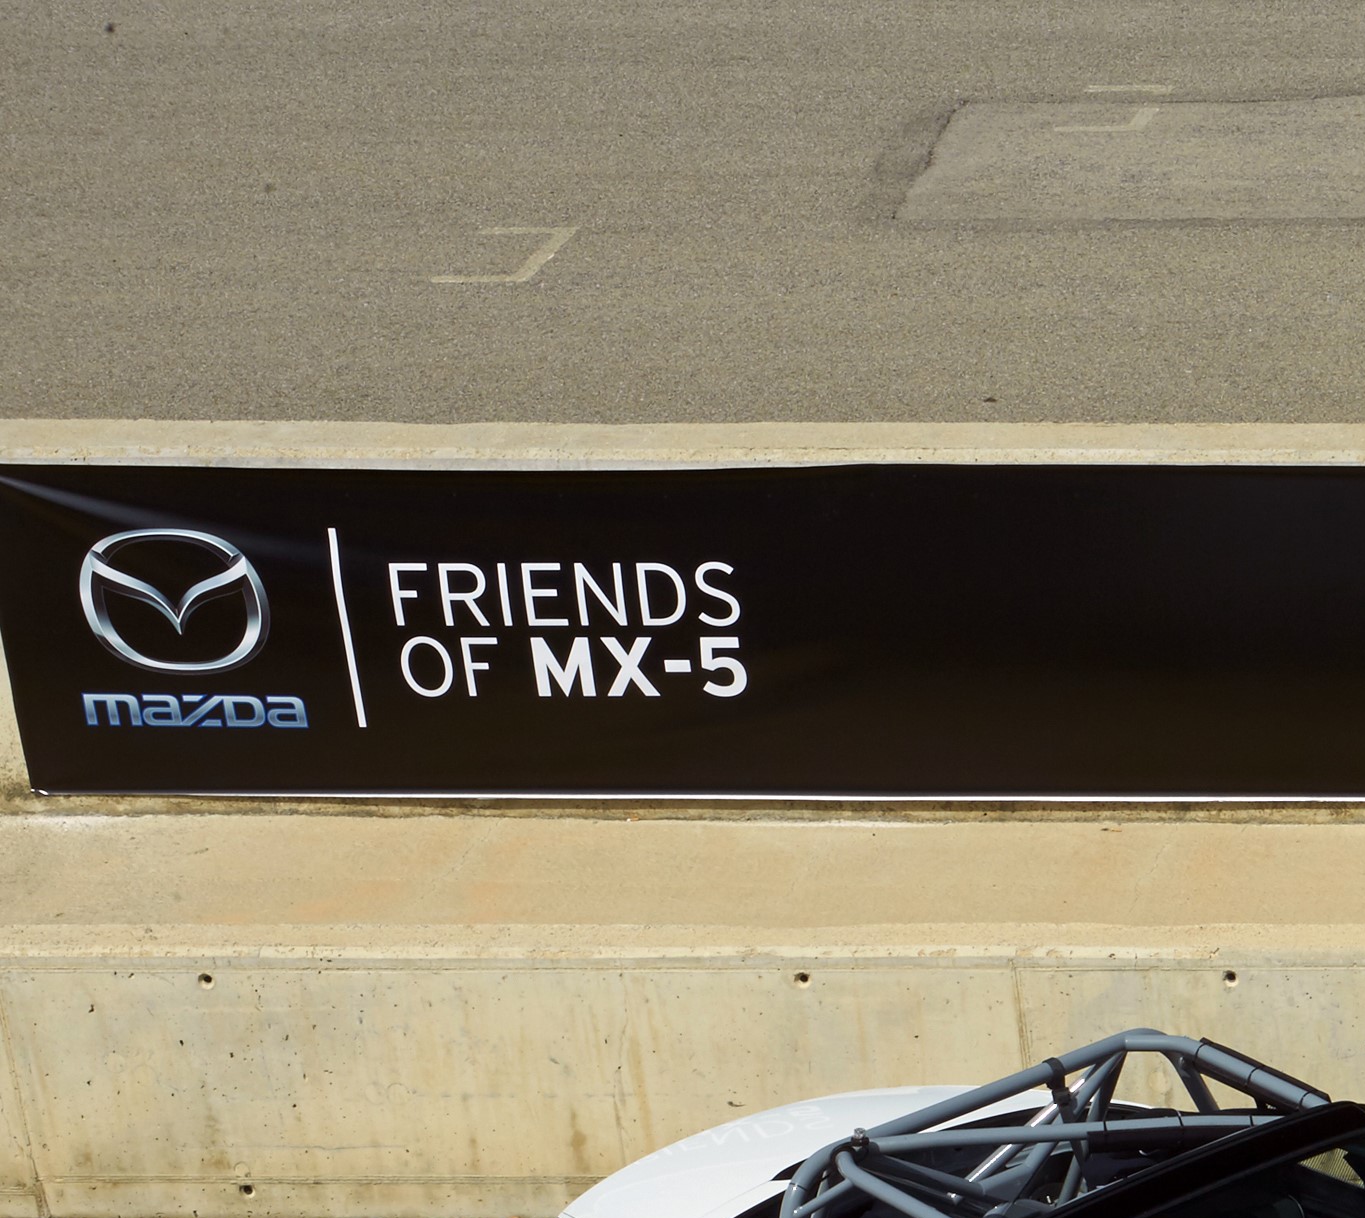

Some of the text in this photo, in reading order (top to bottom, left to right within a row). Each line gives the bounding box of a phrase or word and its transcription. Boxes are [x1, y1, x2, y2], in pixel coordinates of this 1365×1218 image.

[388, 561, 741, 628] FRIENDS
[400, 636, 748, 698] OF MX-5
